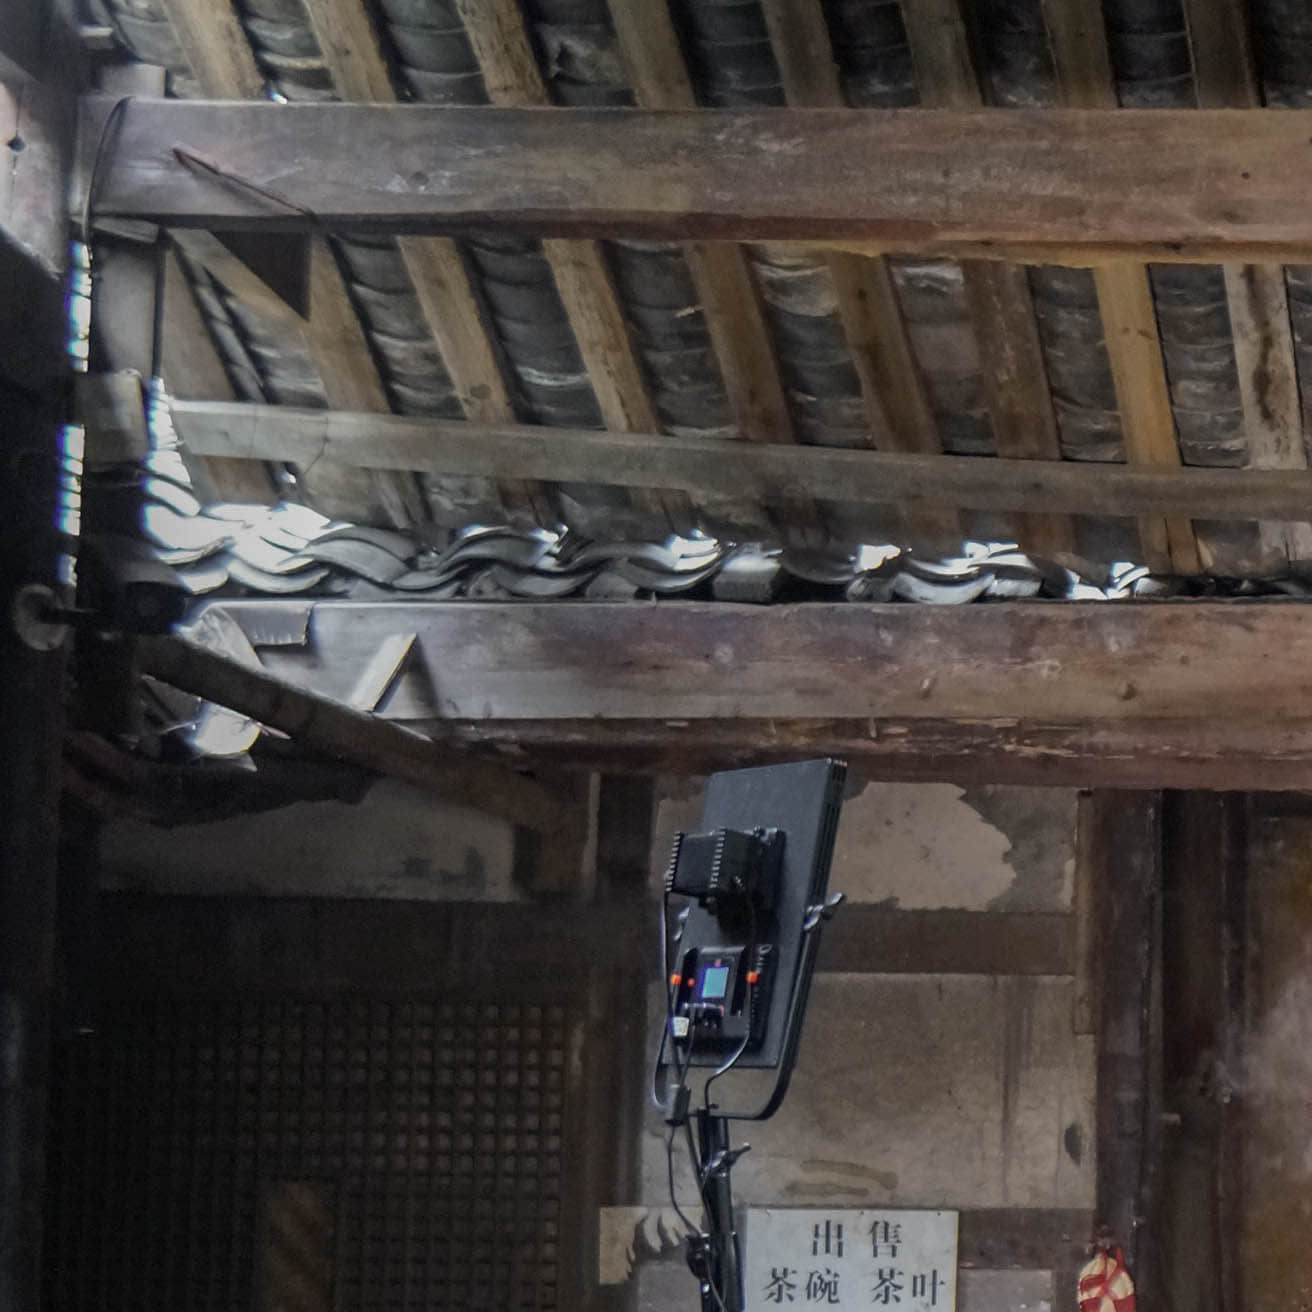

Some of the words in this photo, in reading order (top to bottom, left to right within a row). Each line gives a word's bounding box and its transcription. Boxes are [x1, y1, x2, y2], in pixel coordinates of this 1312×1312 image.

[812, 1219, 902, 1258] 出售
[764, 1267, 840, 1304] 茶碗
[872, 1268, 946, 1306] 茶叶
